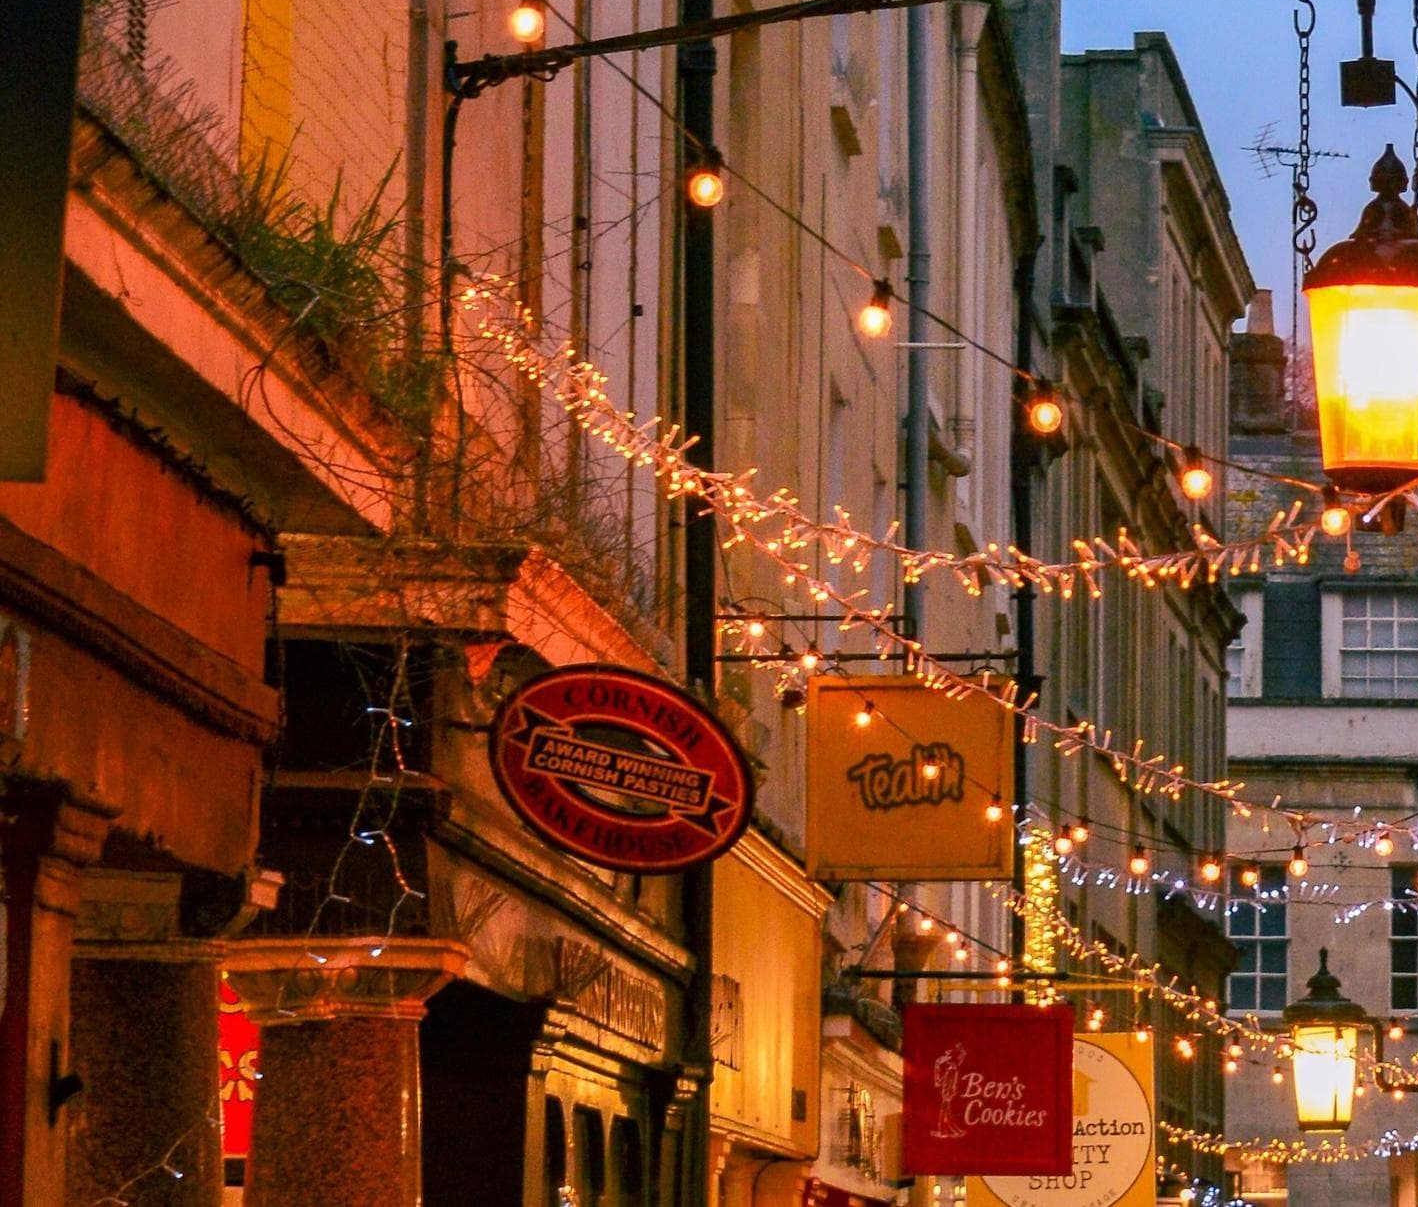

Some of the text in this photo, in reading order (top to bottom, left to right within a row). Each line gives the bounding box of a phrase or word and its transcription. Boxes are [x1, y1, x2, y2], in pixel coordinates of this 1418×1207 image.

[563, 684, 703, 750] CORNISH
[534, 753, 701, 805] CORNISH PASTIES
[542, 740, 700, 788] AWARD WINNING
[525, 779, 684, 857] BAKEHOUSE
[961, 1072, 1027, 1101] Ben's
[963, 1098, 1047, 1128] Cookies
[1073, 1119, 1146, 1136] Action
[1028, 1170, 1093, 1190] SHOP
